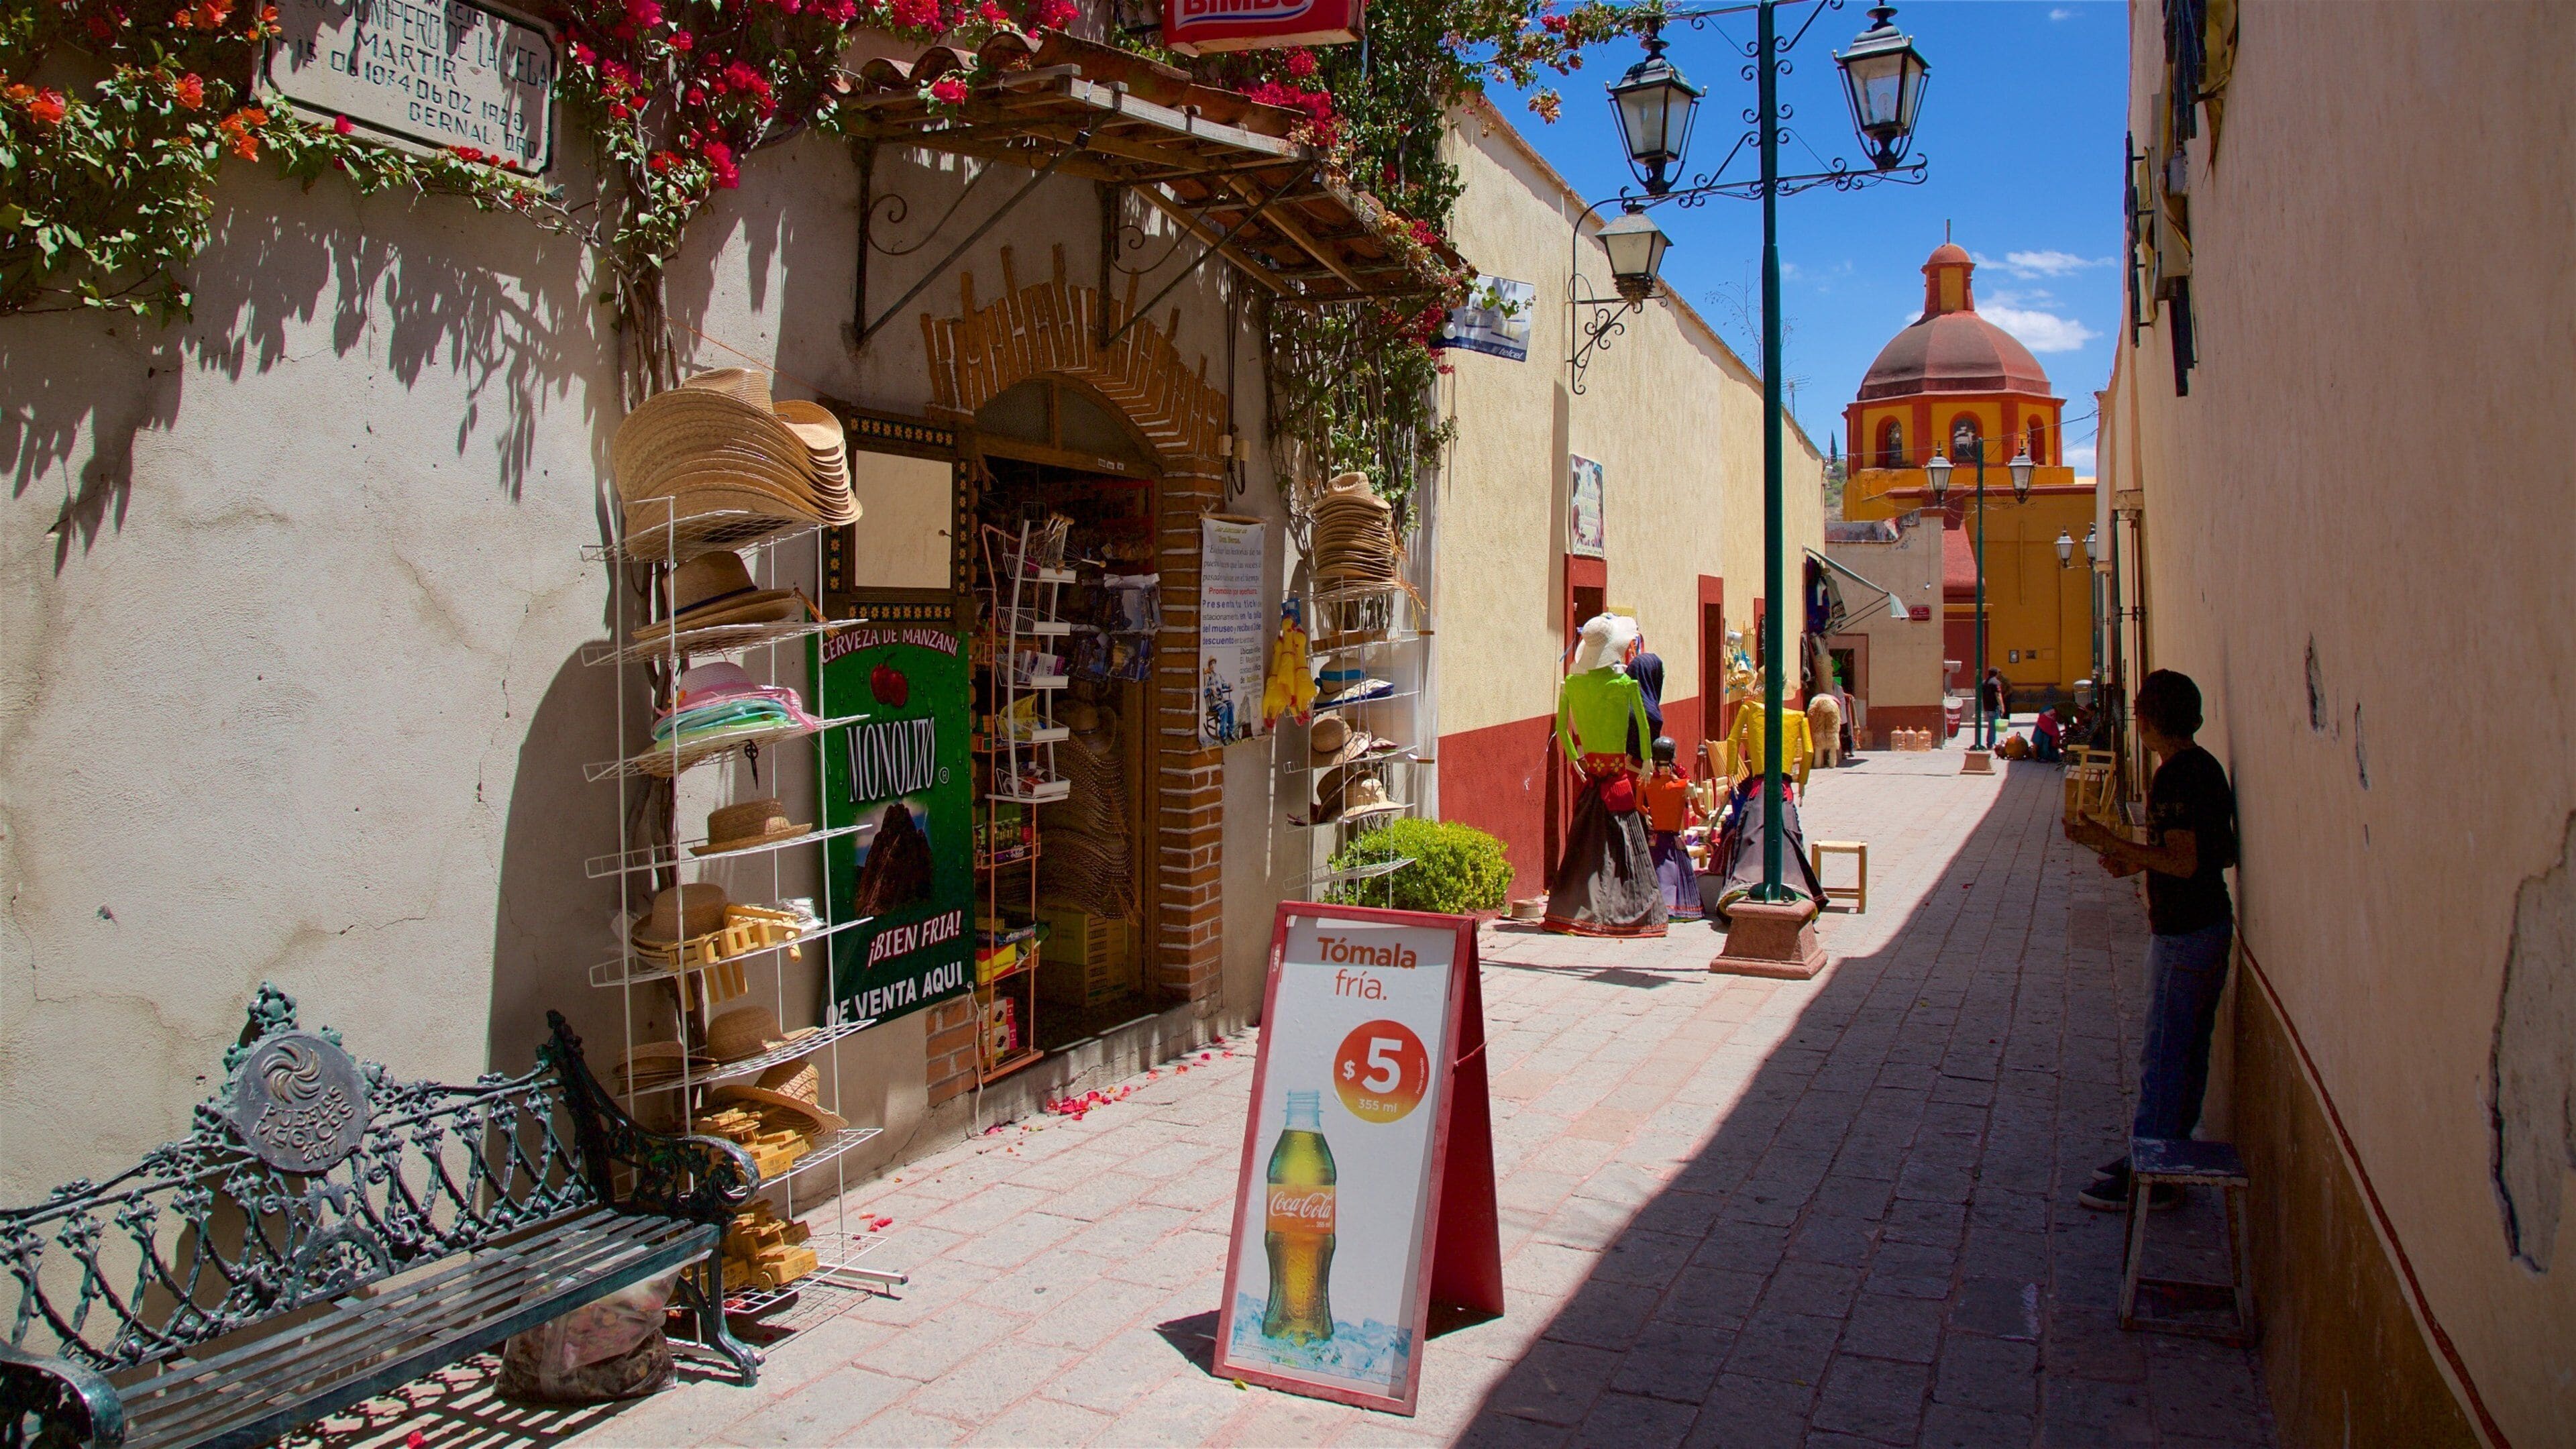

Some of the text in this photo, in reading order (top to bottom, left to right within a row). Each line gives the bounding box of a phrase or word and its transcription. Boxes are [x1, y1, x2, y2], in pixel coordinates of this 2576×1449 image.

[1183, 0, 1306, 15] BIMB
[355, 27, 458, 87] MARTIR
[446, 21, 469, 61] DE
[478, 32, 497, 72] LA
[504, 40, 547, 90] VEGA
[409, 101, 491, 144] BERNAL
[1499, 347, 1523, 359] telcel
[822, 629, 959, 663] CERVEZA DE MANZANA
[1202, 637, 1234, 645] descuento
[846, 716, 934, 802] MONOLITO
[868, 910, 962, 967] ¡BIEN FRIA!
[1318, 937, 1417, 969] Tómala
[826, 961, 963, 1028] DE VENTA AQUI
[1335, 969, 1387, 1001] fría.
[1362, 1036, 1403, 1094] 5
[1415, 1079, 1424, 1095] Precio
[1358, 1098, 1397, 1113] 355 ml
[1270, 1191, 1334, 1218] Coca-Cola
